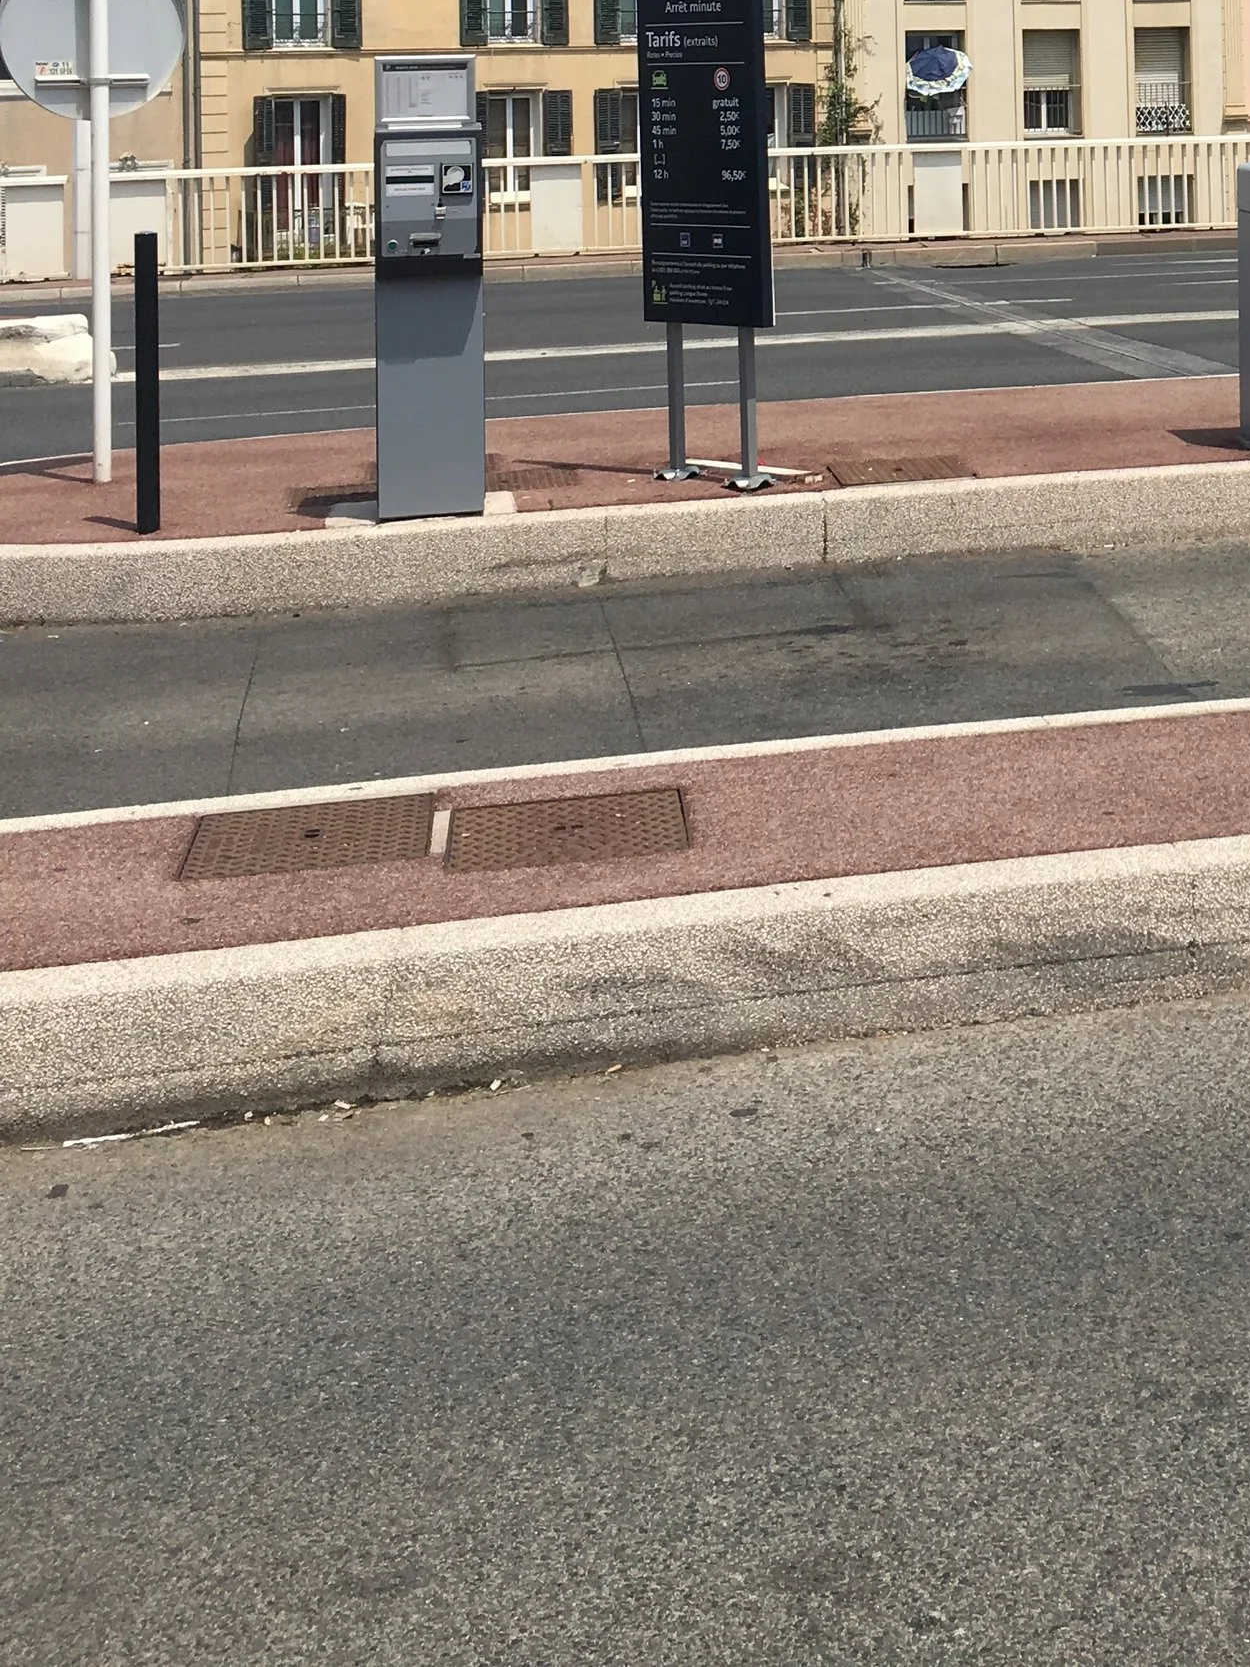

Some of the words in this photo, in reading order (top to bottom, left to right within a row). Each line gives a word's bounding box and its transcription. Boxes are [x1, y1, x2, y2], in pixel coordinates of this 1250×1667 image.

[665, 1, 688, 13] Arrêt
[690, 0, 722, 12] minute
[646, 31, 681, 48] Tarifs
[683, 35, 718, 48] (extraits)
[651, 97, 661, 108] 15
[662, 97, 676, 107] min
[712, 97, 740, 110] gratuit
[651, 111, 661, 122] 30
[662, 111, 676, 122] min
[651, 125, 661, 136] 45
[662, 125, 677, 136] min
[652, 139, 657, 149] 1
[658, 139, 664, 149] h
[653, 169, 663, 180] 12
[663, 169, 669, 180] h
